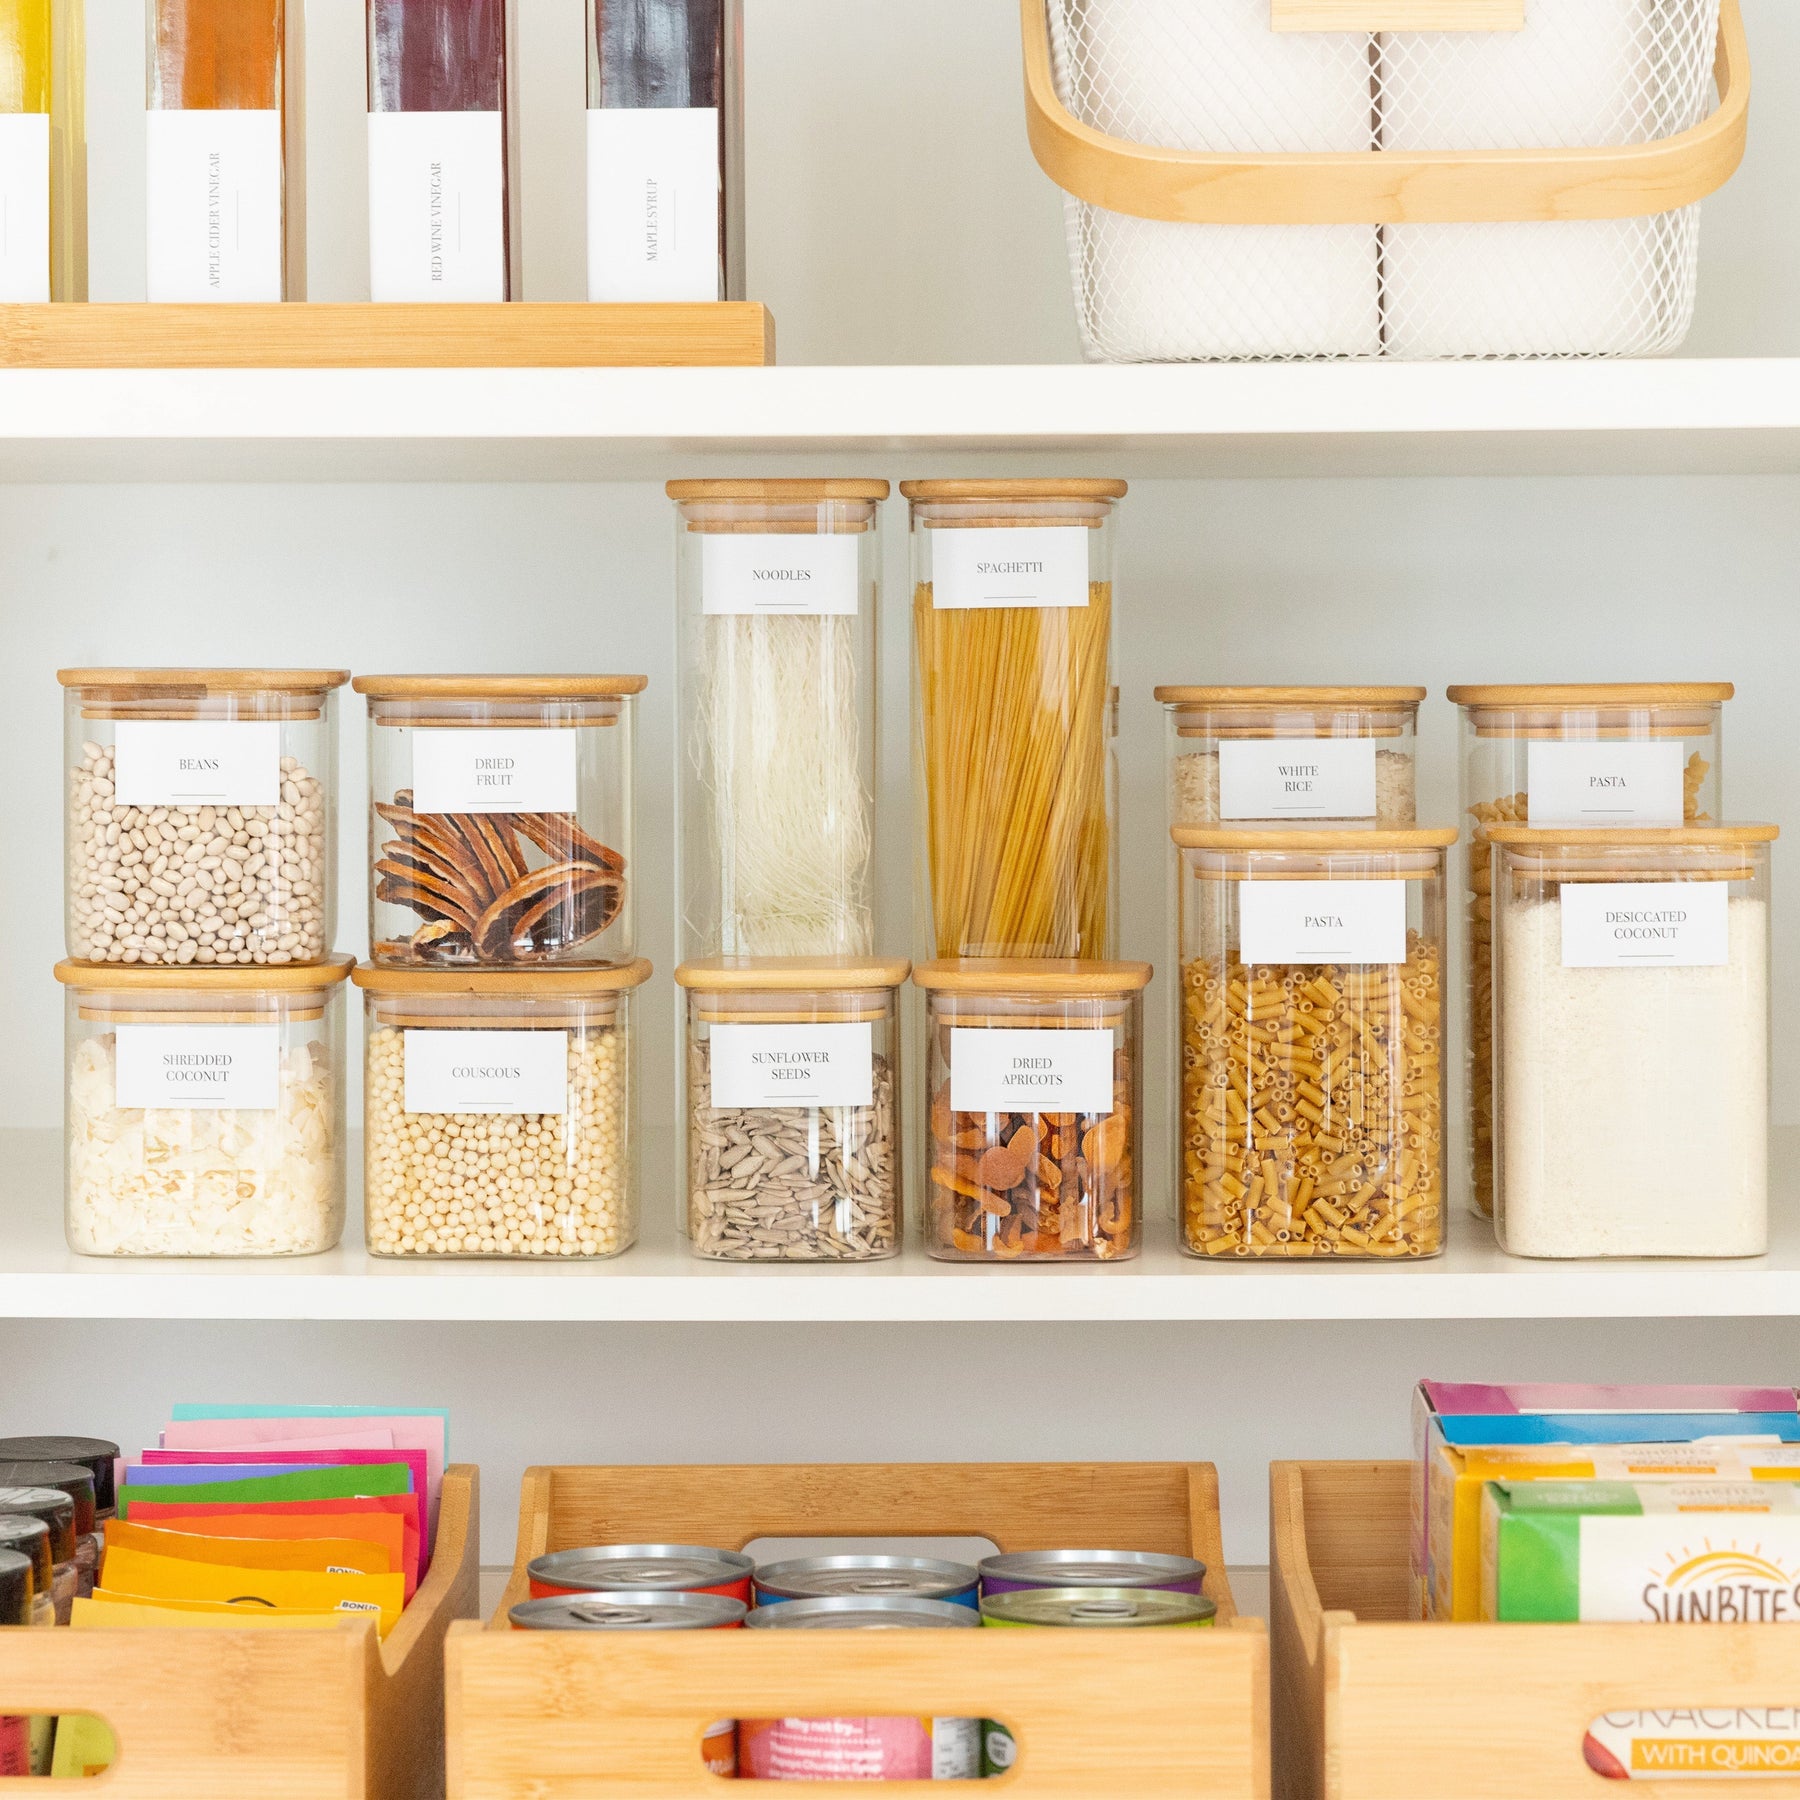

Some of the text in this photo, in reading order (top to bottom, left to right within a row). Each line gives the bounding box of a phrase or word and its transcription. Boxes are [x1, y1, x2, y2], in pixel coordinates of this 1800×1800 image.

[208, 152, 220, 289] APPLE CIDER VINEGAR
[430, 162, 443, 281] RED WINE VINEGAR
[646, 178, 658, 261] MAPLE SYRUP
[976, 561, 1043, 574] SPAGHETTI
[752, 569, 811, 581] NOODLES
[179, 758, 220, 770] BEANS
[475, 758, 515, 770] DRIED
[1277, 765, 1319, 777] WHITE
[476, 774, 513, 786] FRUIT
[1284, 780, 1313, 792] RICE
[1589, 776, 1627, 788] PASTA
[1304, 915, 1344, 928] PASTA
[1605, 910, 1687, 923] DESICCATED
[1613, 927, 1679, 940] COCONUT
[162, 1054, 233, 1066] SHREDDED
[751, 1051, 830, 1064] SUNFLOWER
[1013, 1057, 1053, 1070] DRIED
[166, 1070, 230, 1082] COCONUT
[451, 1067, 521, 1079] COUSCOUS
[771, 1068, 811, 1080] SEEDS
[1001, 1073, 1063, 1086] APRICOTS
[329, 1567, 364, 1576] BON
[1642, 1744, 1705, 1764] WITH
